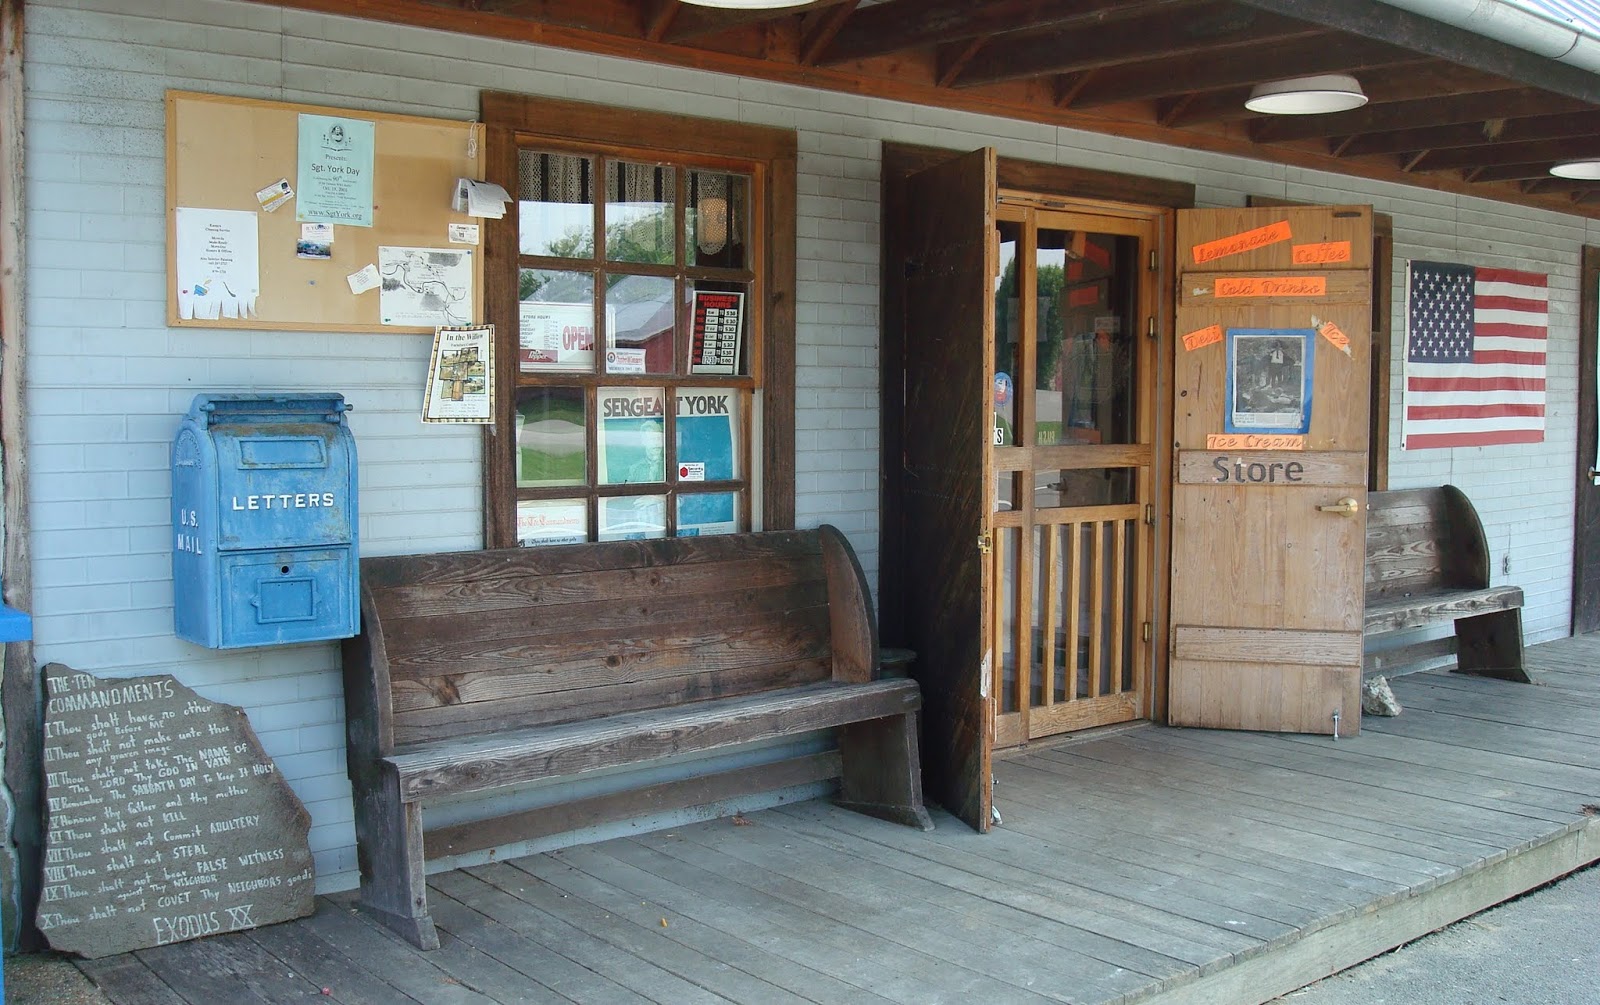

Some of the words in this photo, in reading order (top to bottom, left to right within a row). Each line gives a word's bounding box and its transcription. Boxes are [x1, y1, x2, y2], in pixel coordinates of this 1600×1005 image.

[312, 163, 326, 172] Sgt.
[328, 165, 344, 173] York
[346, 166, 360, 176] Day
[308, 210, 362, 220] www.SgtYork.org
[1199, 227, 1279, 262] Lemonade
[1295, 243, 1347, 263] Coffee
[1220, 279, 1255, 296] Cold
[1261, 279, 1321, 294] Drinks
[563, 326, 593, 350] OPEN
[1322, 324, 1348, 344] Ice
[604, 396, 683, 417] SERGEAT
[685, 395, 729, 415] YORK
[1209, 436, 1238, 448] Ice
[1244, 435, 1302, 448] Cream
[1212, 456, 1304, 482] Store
[232, 492, 334, 511] LETTERS
[178, 534, 202, 555] MAIL
[47, 676, 70, 693] THE
[74, 674, 96, 689] TEN
[49, 680, 174, 713] COMMANDMENTS
[53, 721, 82, 736] Thou
[92, 712, 119, 731] shalt
[128, 710, 155, 723] have
[162, 711, 175, 719] no
[184, 701, 211, 715] other
[86, 729, 107, 742] gods
[149, 720, 164, 729] ME
[54, 746, 79, 760] Thou
[87, 740, 111, 755] shalt
[119, 735, 136, 750] not
[144, 732, 171, 745] make
[179, 727, 202, 740] unto
[208, 723, 230, 735] thee
[59, 771, 84, 784] Thou
[91, 766, 115, 780] shalt
[124, 761, 138, 775] not
[173, 755, 194, 765] The
[199, 746, 230, 760] NAME
[86, 756, 102, 767] any
[110, 751, 139, 764] graven
[144, 746, 171, 756] image
[61, 795, 103, 809] Remember
[110, 790, 126, 800] The
[132, 780, 175, 796] SABBATH
[180, 776, 196, 788] DAY
[253, 763, 274, 775] HOLY
[69, 785, 90, 793] The
[100, 776, 125, 788] LORD
[134, 773, 152, 784] Thy
[158, 767, 179, 778] GOD
[186, 762, 198, 772] IN
[206, 757, 231, 769] VAIN
[60, 815, 96, 826] Honour
[104, 807, 120, 819] thy
[128, 801, 156, 814] father
[166, 794, 182, 808] and
[190, 792, 207, 804] thy
[63, 847, 92, 860] Thou
[101, 839, 126, 854] shalt
[135, 832, 154, 846] not
[210, 815, 260, 834] ADULTERY
[65, 830, 92, 840] Thou
[100, 821, 127, 835] shalt
[136, 816, 154, 828] not
[163, 812, 187, 824] KILL
[61, 884, 89, 898] Thou
[98, 878, 124, 893] shalt
[134, 872, 151, 886] not
[164, 867, 186, 880] bear
[196, 858, 228, 873] FALSE
[239, 849, 284, 866] WITNESS
[66, 865, 96, 877] Thou
[107, 855, 135, 871] shalt
[144, 850, 162, 864] not
[173, 844, 209, 859] STEAL
[118, 887, 144, 900] against
[150, 884, 166, 893] Thy
[174, 874, 217, 887] NEIGHBOR
[54, 913, 80, 925] Thou
[89, 905, 117, 920] shalt
[128, 899, 146, 913] not
[158, 891, 191, 908] COVET
[200, 889, 220, 901] Thy
[228, 876, 281, 894] NEIGHBORS
[153, 911, 220, 945] EXODUS
[225, 904, 256, 931] XX
